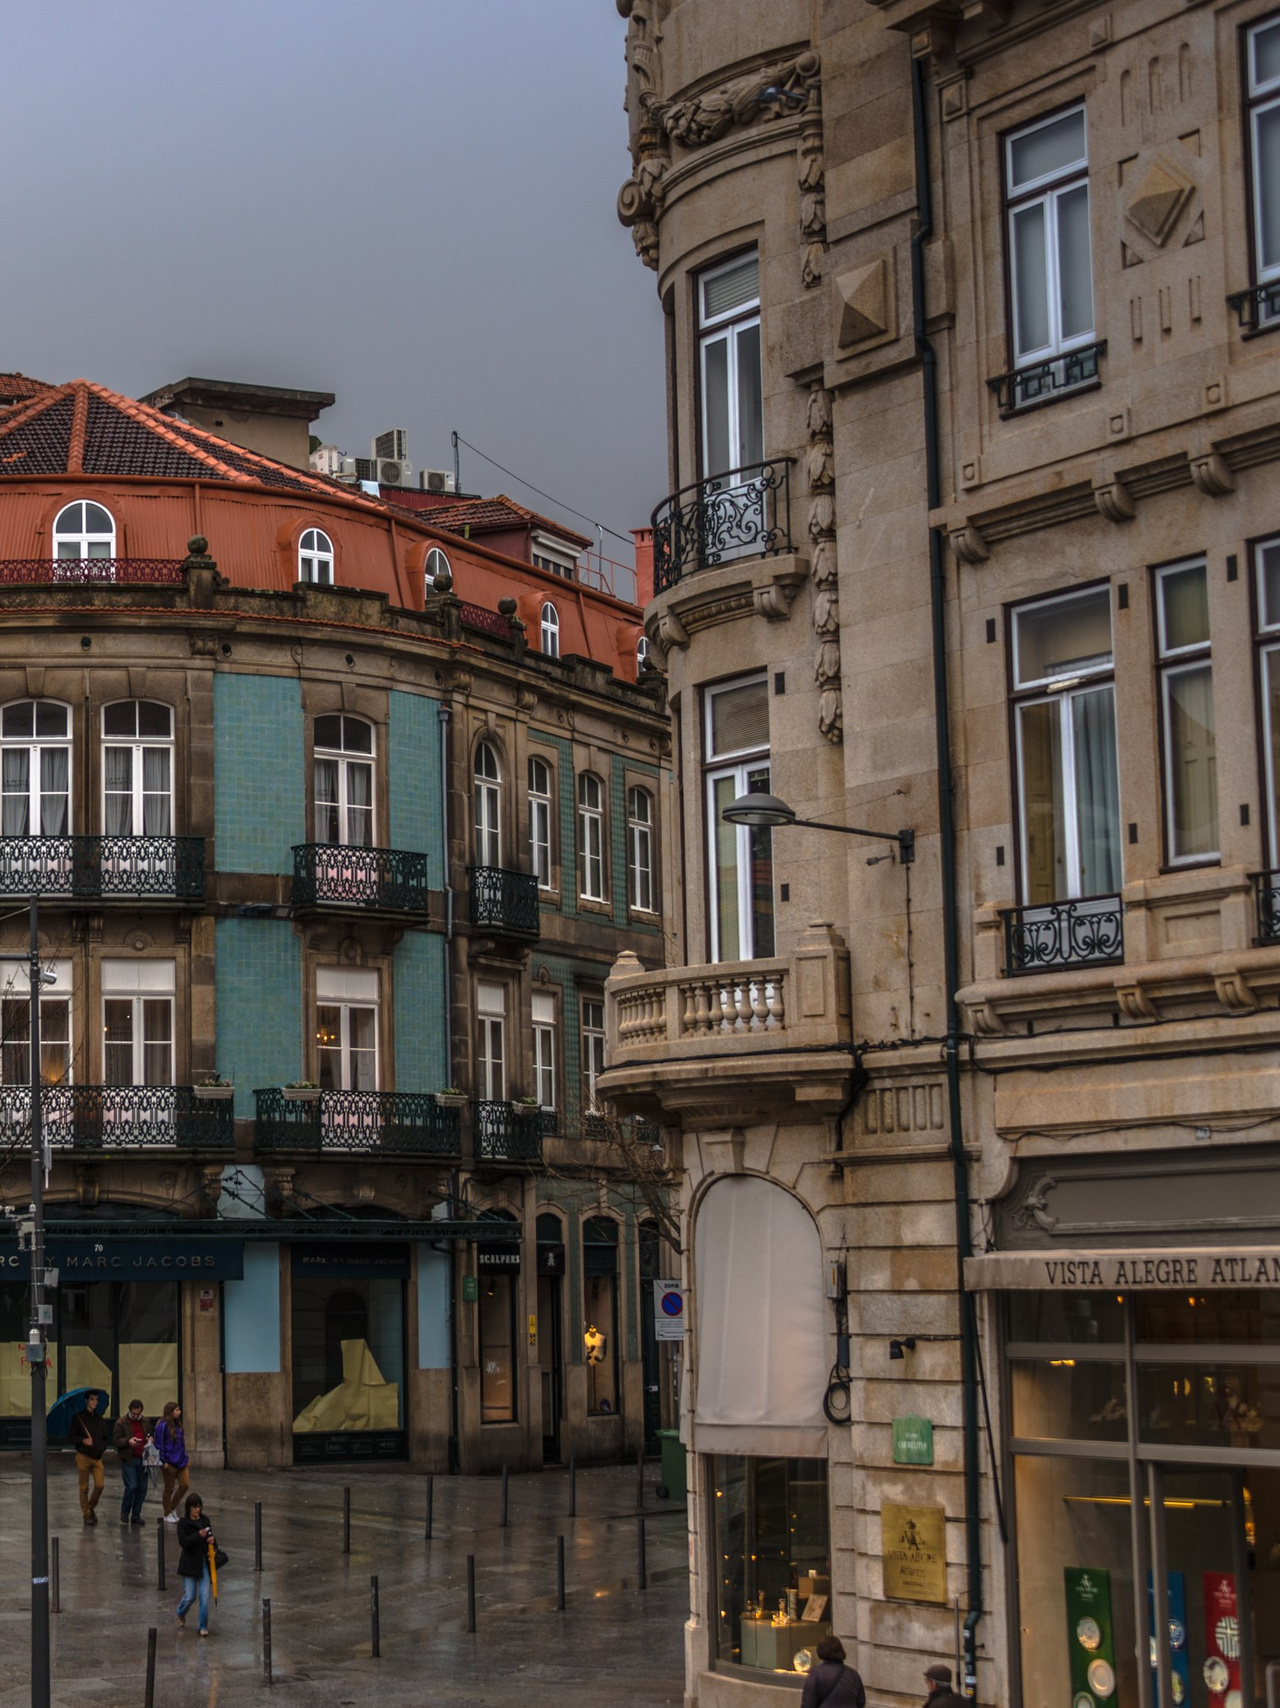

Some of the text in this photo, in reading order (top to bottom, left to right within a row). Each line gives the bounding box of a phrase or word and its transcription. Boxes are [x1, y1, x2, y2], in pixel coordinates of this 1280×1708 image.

[94, 1244, 104, 1252] 70
[66, 1256, 121, 1267] MARC
[133, 1256, 216, 1267] JACOBS
[479, 1254, 520, 1264] SCALPERS
[1045, 1260, 1104, 1285] VISTA
[1114, 1259, 1199, 1285] ALEGRE
[888, 1550, 937, 1563] VISTA ALEGRE
